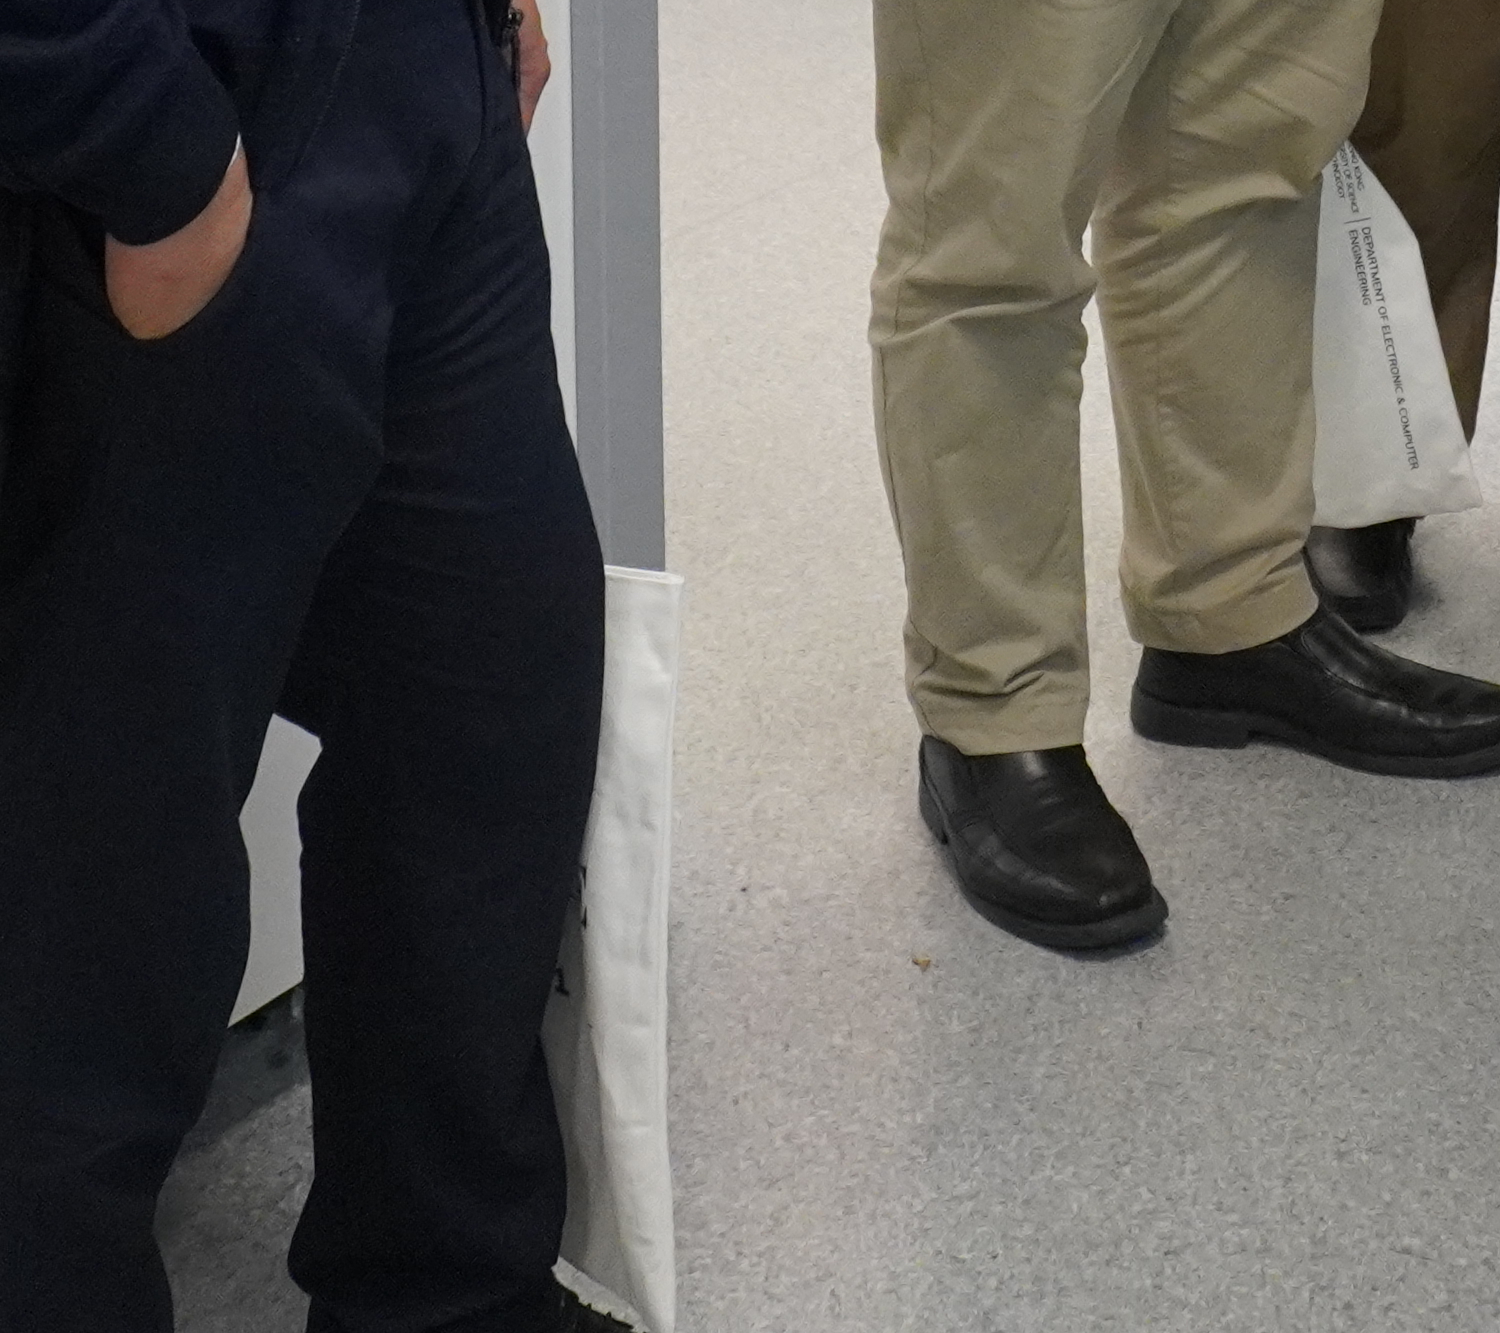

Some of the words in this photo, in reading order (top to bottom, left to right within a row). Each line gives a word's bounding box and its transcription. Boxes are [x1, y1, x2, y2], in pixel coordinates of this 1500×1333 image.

[1349, 228, 1372, 306] ENGINEERING
[1361, 226, 1386, 303] DEPARTMENT
[1377, 305, 1389, 323] OF
[1381, 325, 1404, 395] ELECTRONIC
[1396, 397, 1406, 405] &
[1398, 407, 1420, 471] COMPUTER
